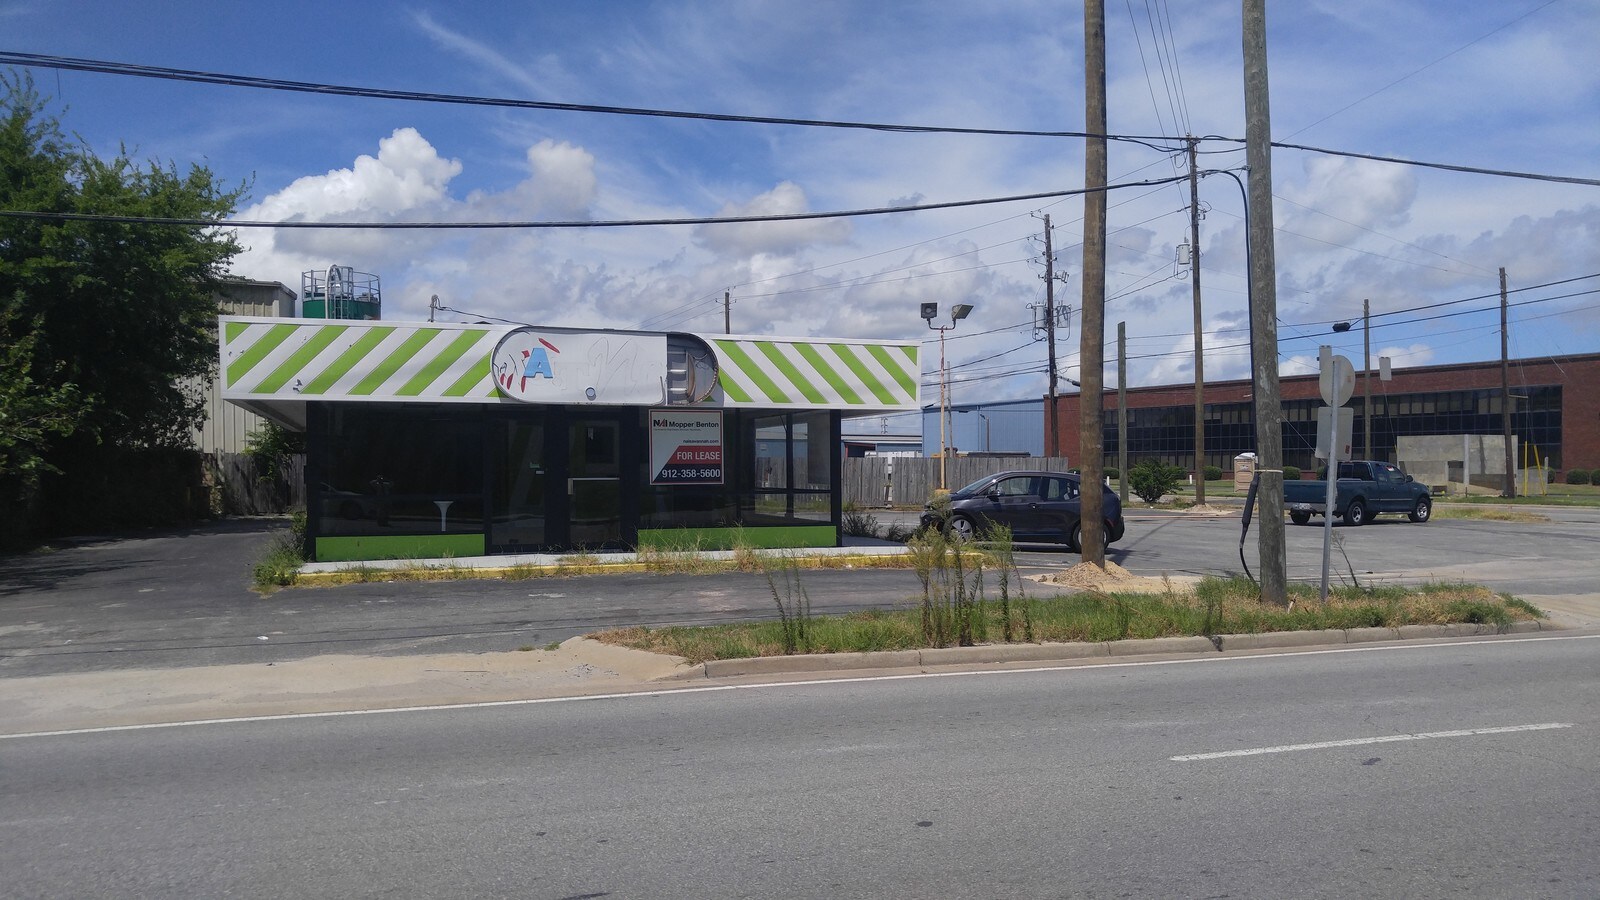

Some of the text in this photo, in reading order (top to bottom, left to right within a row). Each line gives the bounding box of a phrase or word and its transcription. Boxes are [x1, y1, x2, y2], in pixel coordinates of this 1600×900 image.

[653, 419, 668, 427] NAI
[677, 451, 720, 460] FOR LEASE
[662, 469, 721, 478] 912-358-5600
